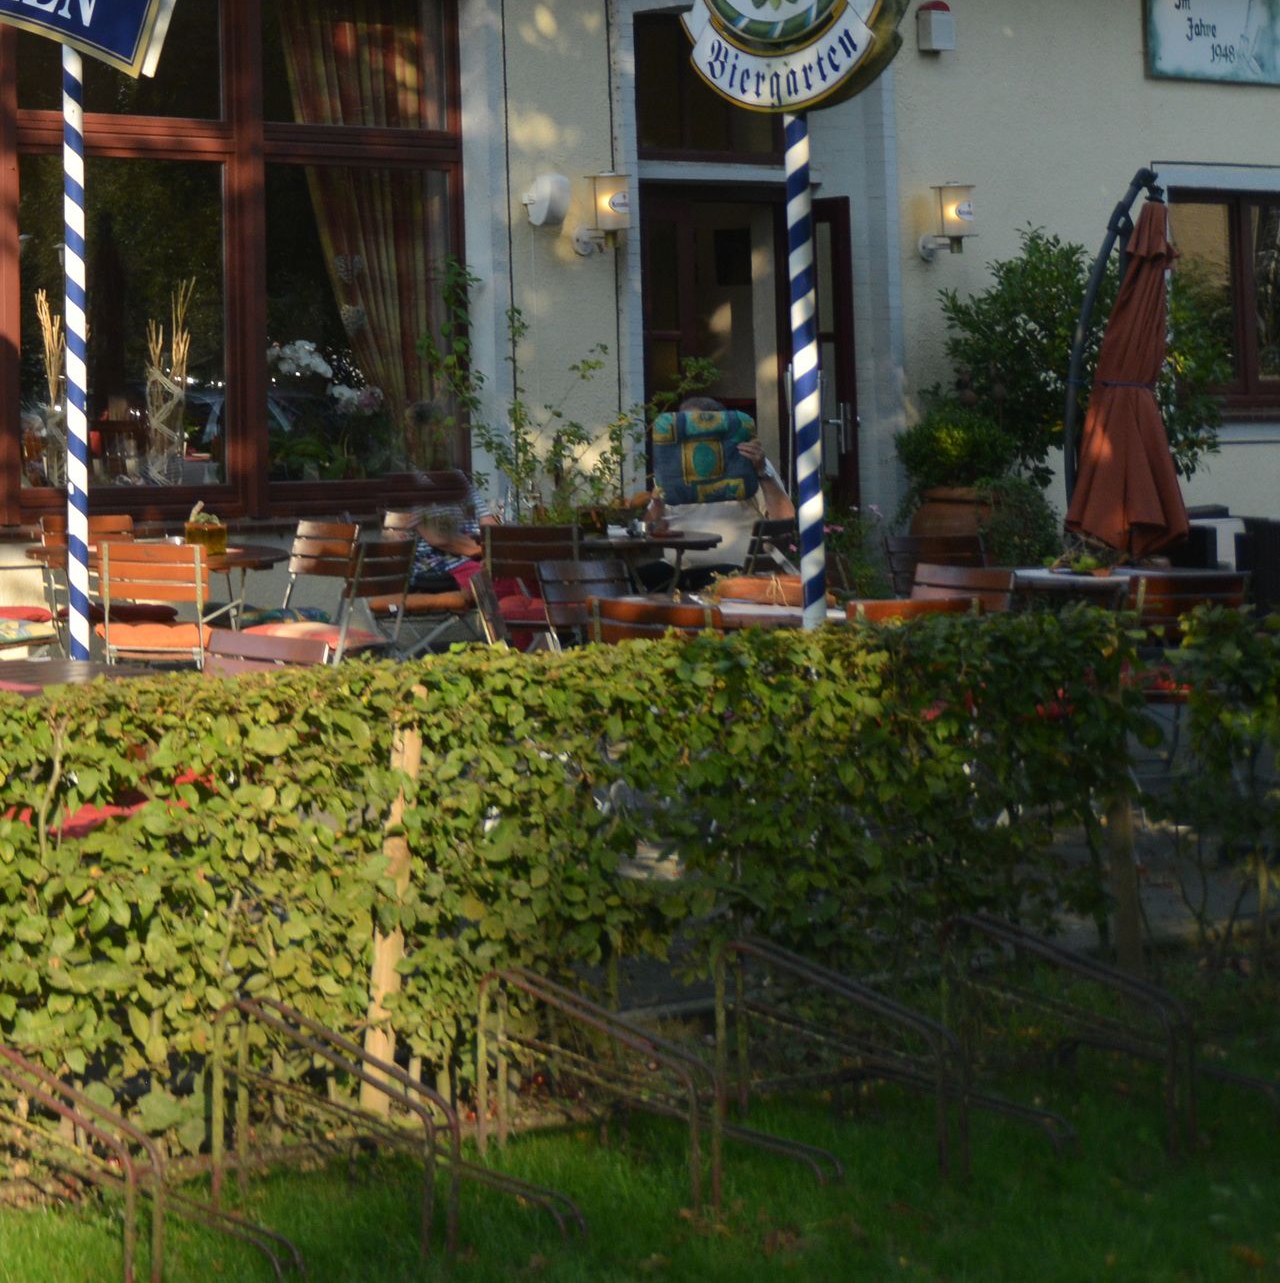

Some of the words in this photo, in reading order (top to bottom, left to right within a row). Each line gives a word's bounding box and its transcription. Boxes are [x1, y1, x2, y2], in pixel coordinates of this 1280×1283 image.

[1186, 17, 1217, 41] Jahre
[1210, 44, 1235, 63] 1948
[707, 29, 858, 107] Biergarten
